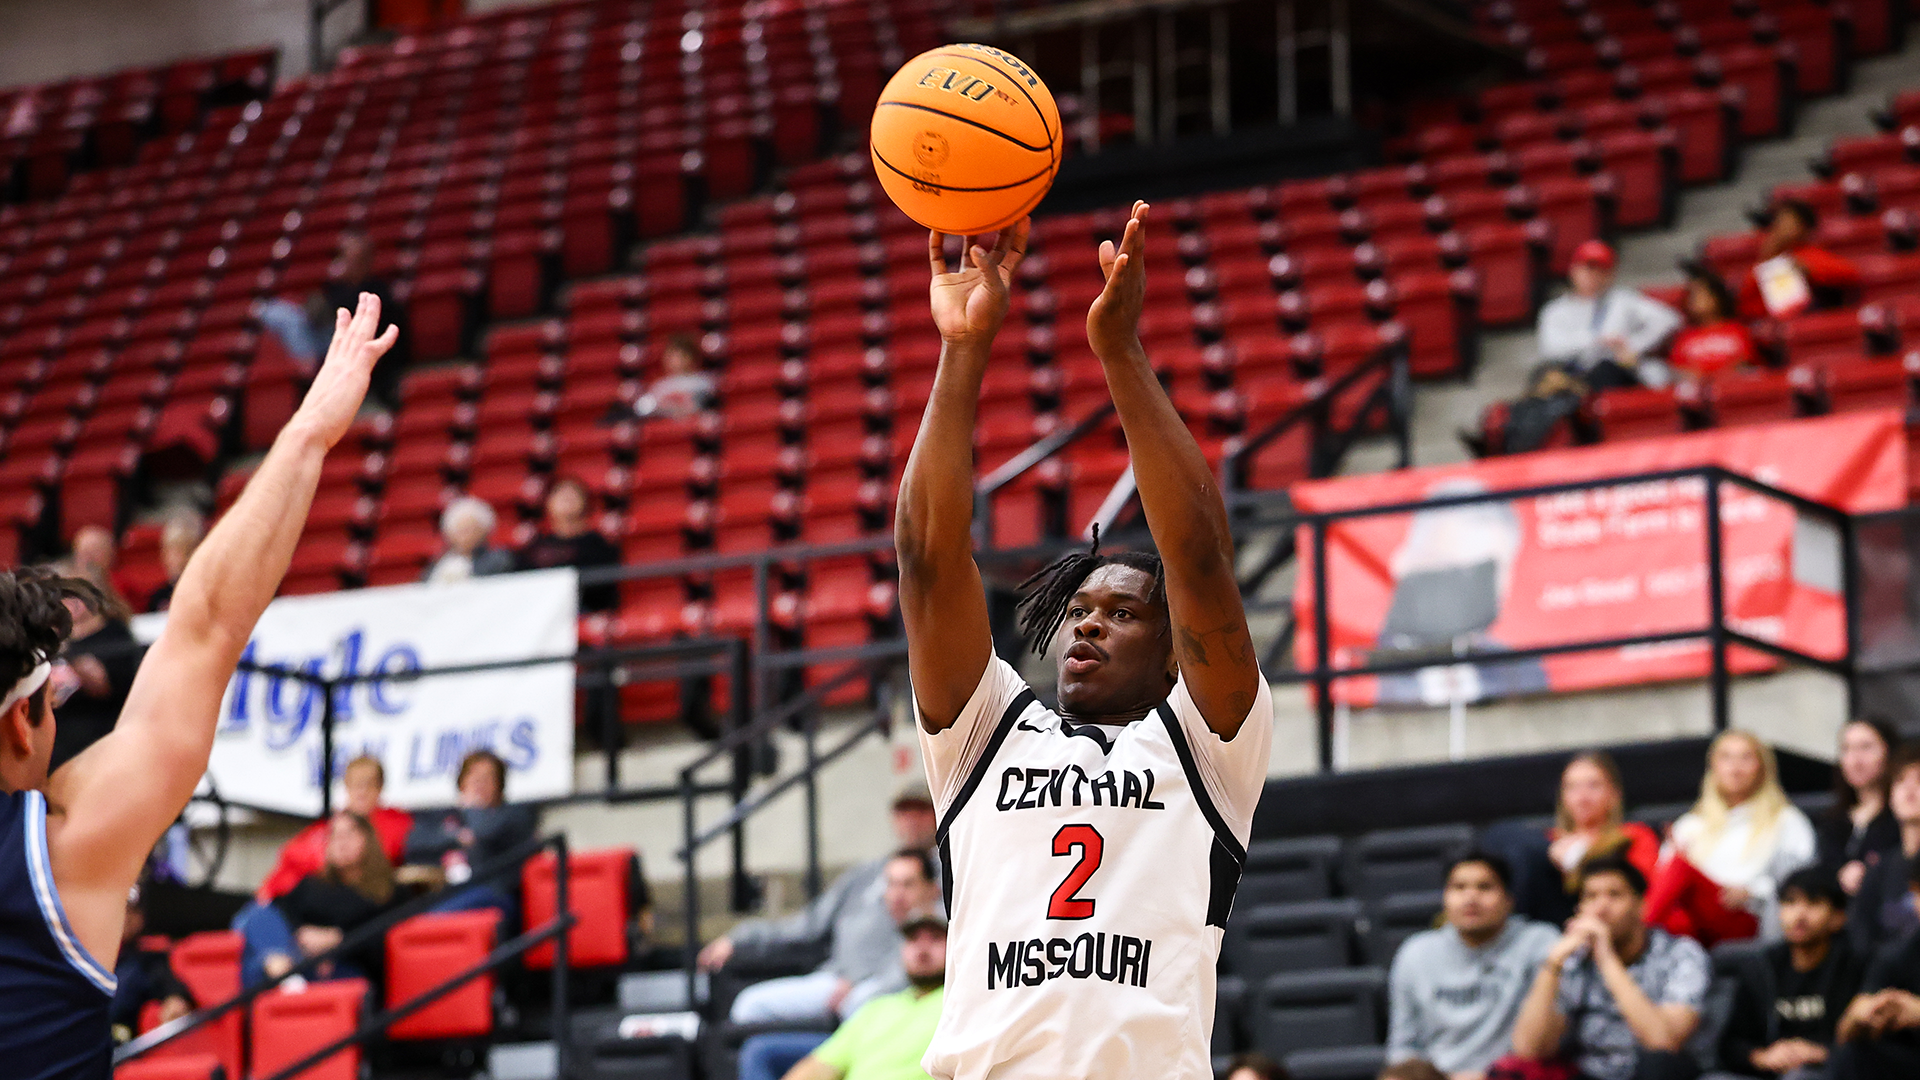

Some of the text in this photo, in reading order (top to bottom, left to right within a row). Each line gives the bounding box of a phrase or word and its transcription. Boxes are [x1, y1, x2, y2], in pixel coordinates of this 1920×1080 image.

[917, 67, 995, 104] EVO
[996, 764, 1165, 811] CENTRAL
[1046, 823, 1105, 920] 2
[987, 932, 1152, 990] MISSOURI
